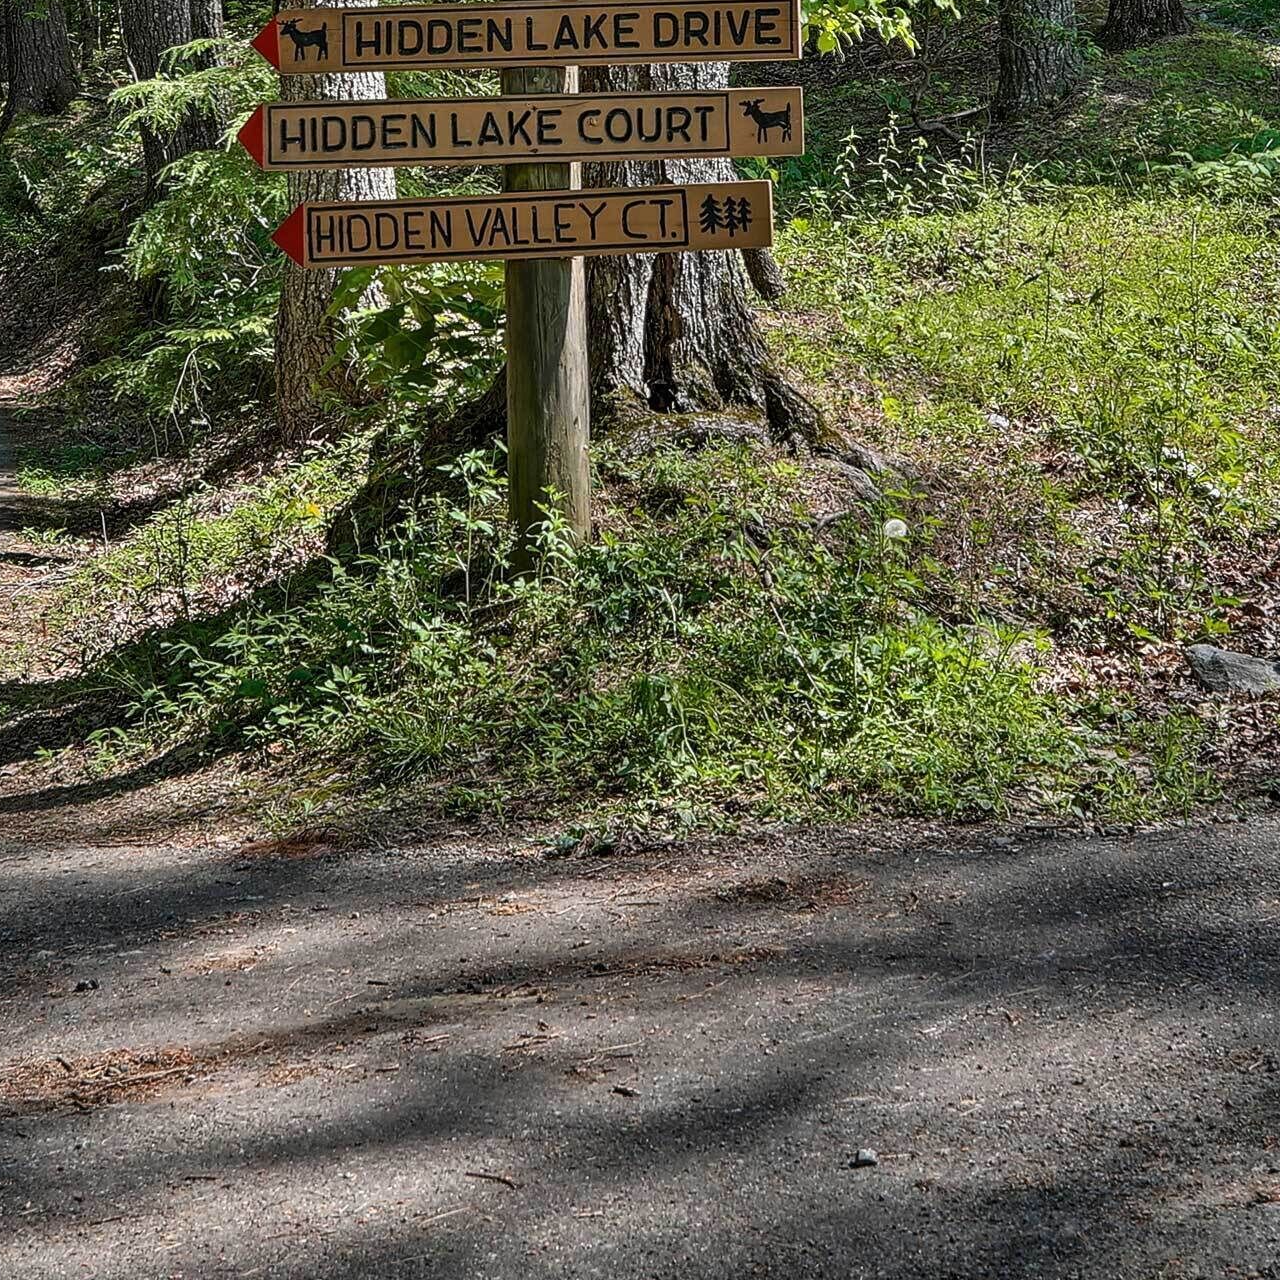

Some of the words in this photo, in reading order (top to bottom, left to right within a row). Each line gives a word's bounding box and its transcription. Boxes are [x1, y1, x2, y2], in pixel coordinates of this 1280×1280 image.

[355, 17, 514, 57] HIDDEN
[527, 13, 640, 52] LAKE
[653, 8, 782, 47] DRIVE
[280, 113, 437, 153] HIDDEN
[450, 109, 563, 148] LAKE
[577, 105, 714, 144] COURT
[315, 209, 452, 254] HIDDEN
[465, 202, 607, 246] VALLEY
[622, 200, 677, 240] CT.
